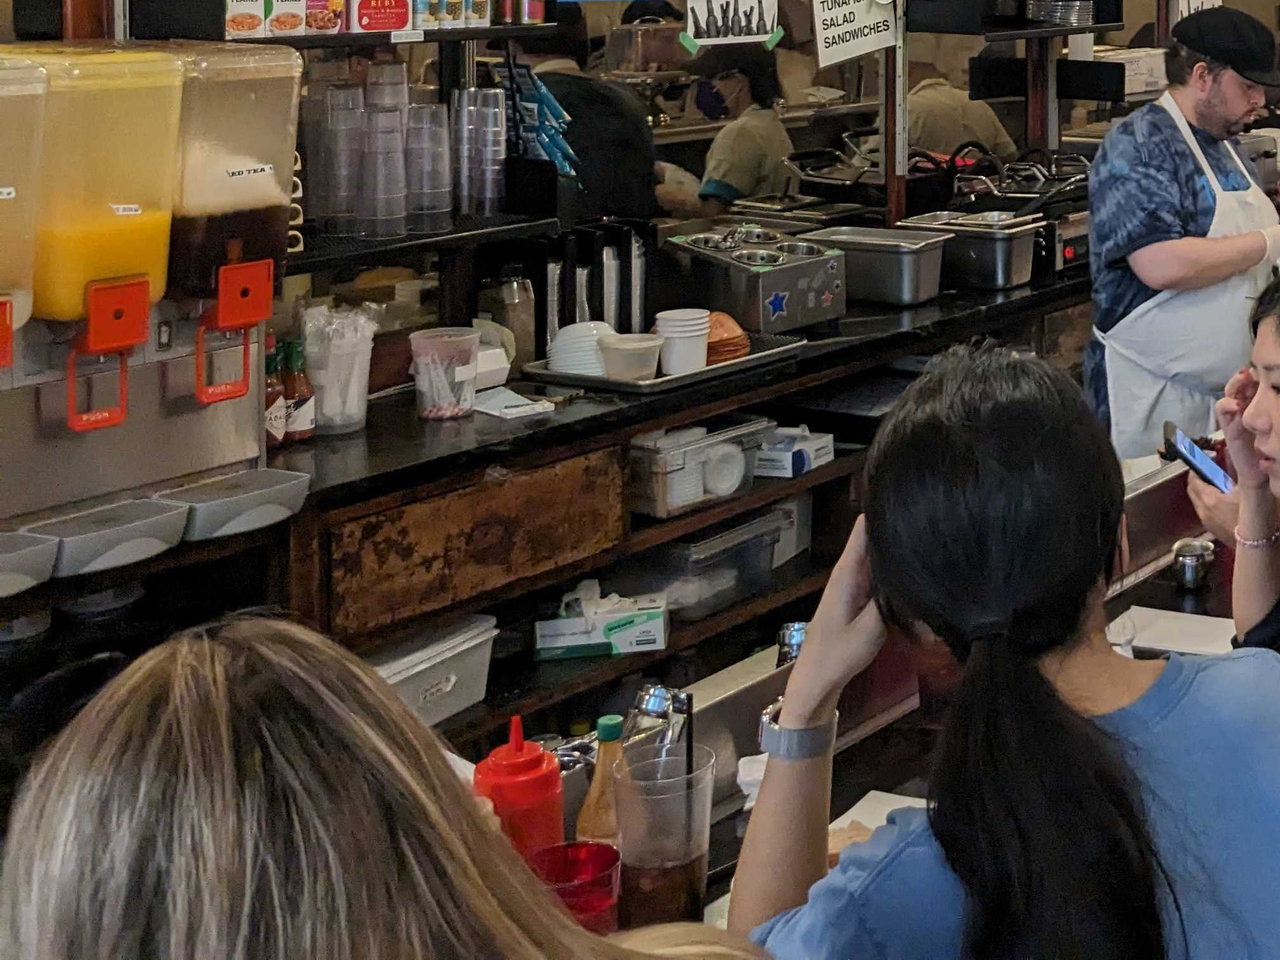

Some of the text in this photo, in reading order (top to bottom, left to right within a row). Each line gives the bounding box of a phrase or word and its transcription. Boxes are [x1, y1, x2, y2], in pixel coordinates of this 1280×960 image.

[822, 11, 856, 31] SALAD
[823, 19, 890, 49] SANDWICHES
[245, 167, 266, 175] TEA
